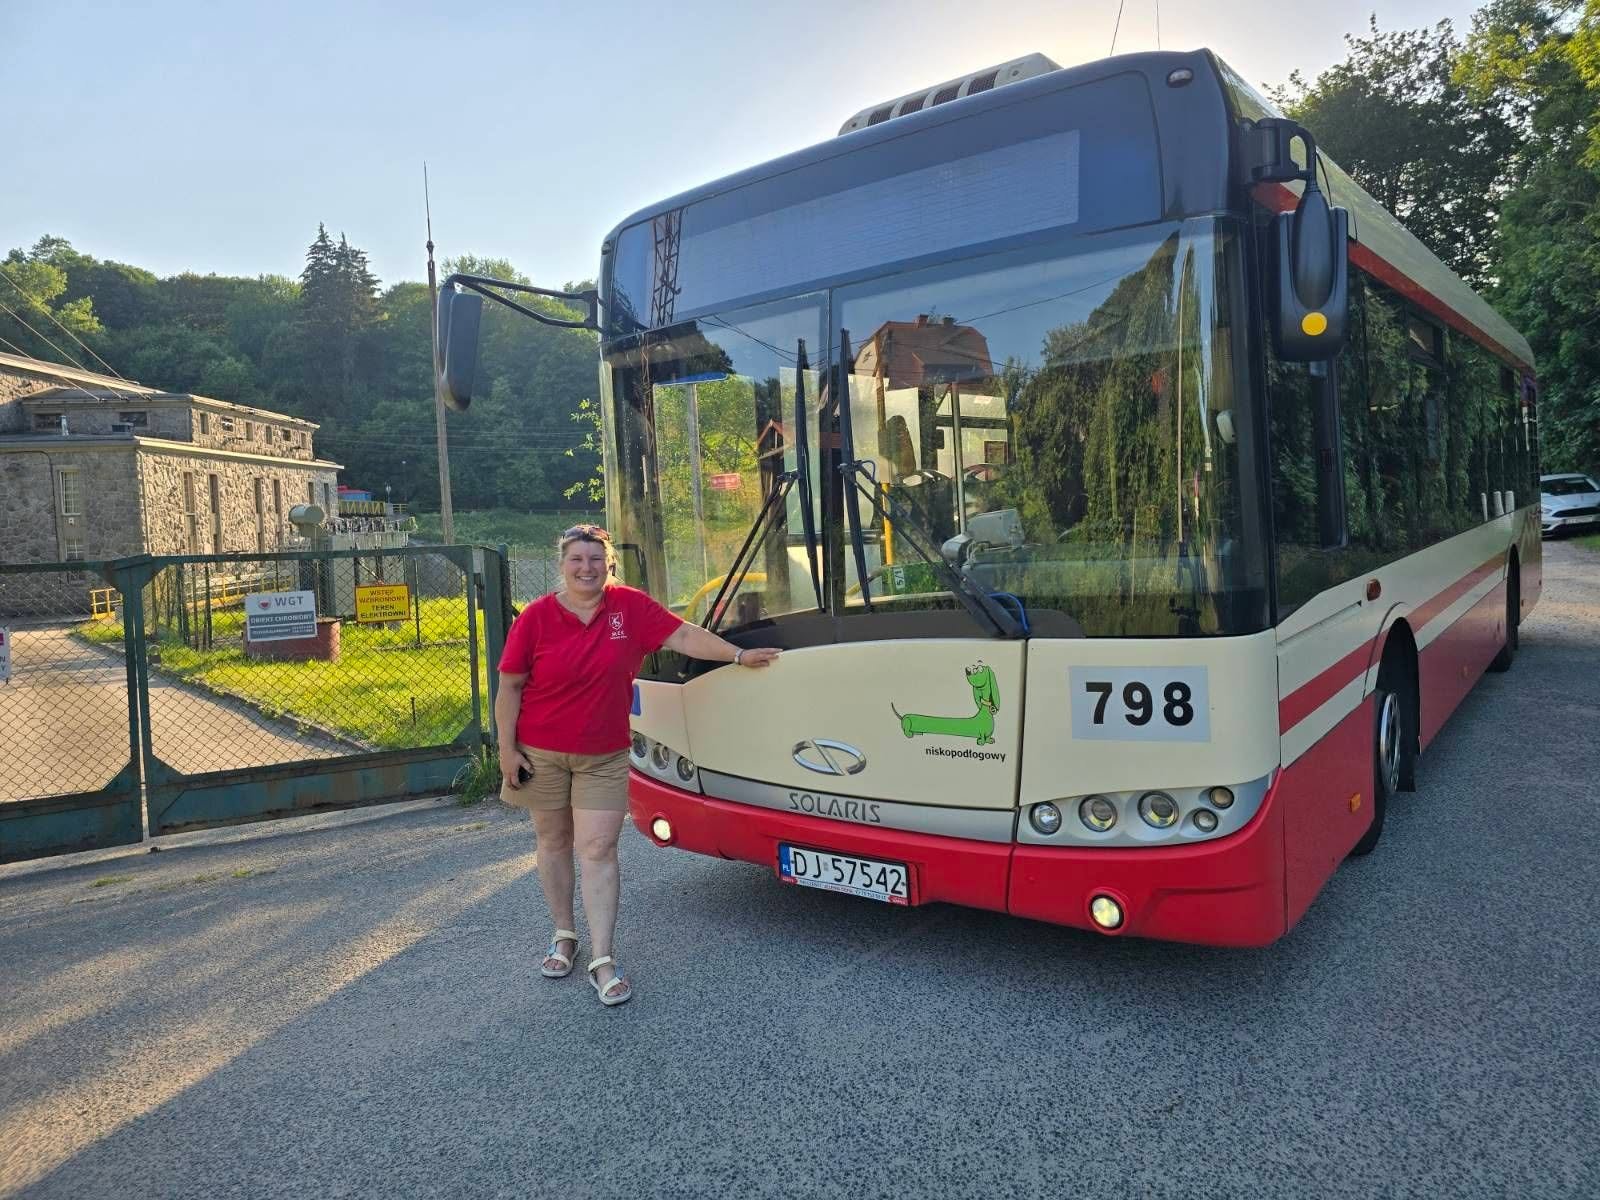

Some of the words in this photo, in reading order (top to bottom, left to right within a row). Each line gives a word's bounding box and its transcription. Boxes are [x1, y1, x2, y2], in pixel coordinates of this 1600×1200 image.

[274, 596, 304, 607] WGT
[360, 610, 406, 619] ELEKTROWNI
[1086, 681, 1194, 727] 798
[925, 746, 1006, 763] niskopodłogowy
[789, 792, 881, 823] SOLARIS
[782, 863, 790, 872] PL
[793, 851, 822, 879] DJ
[831, 858, 903, 895] 57542
